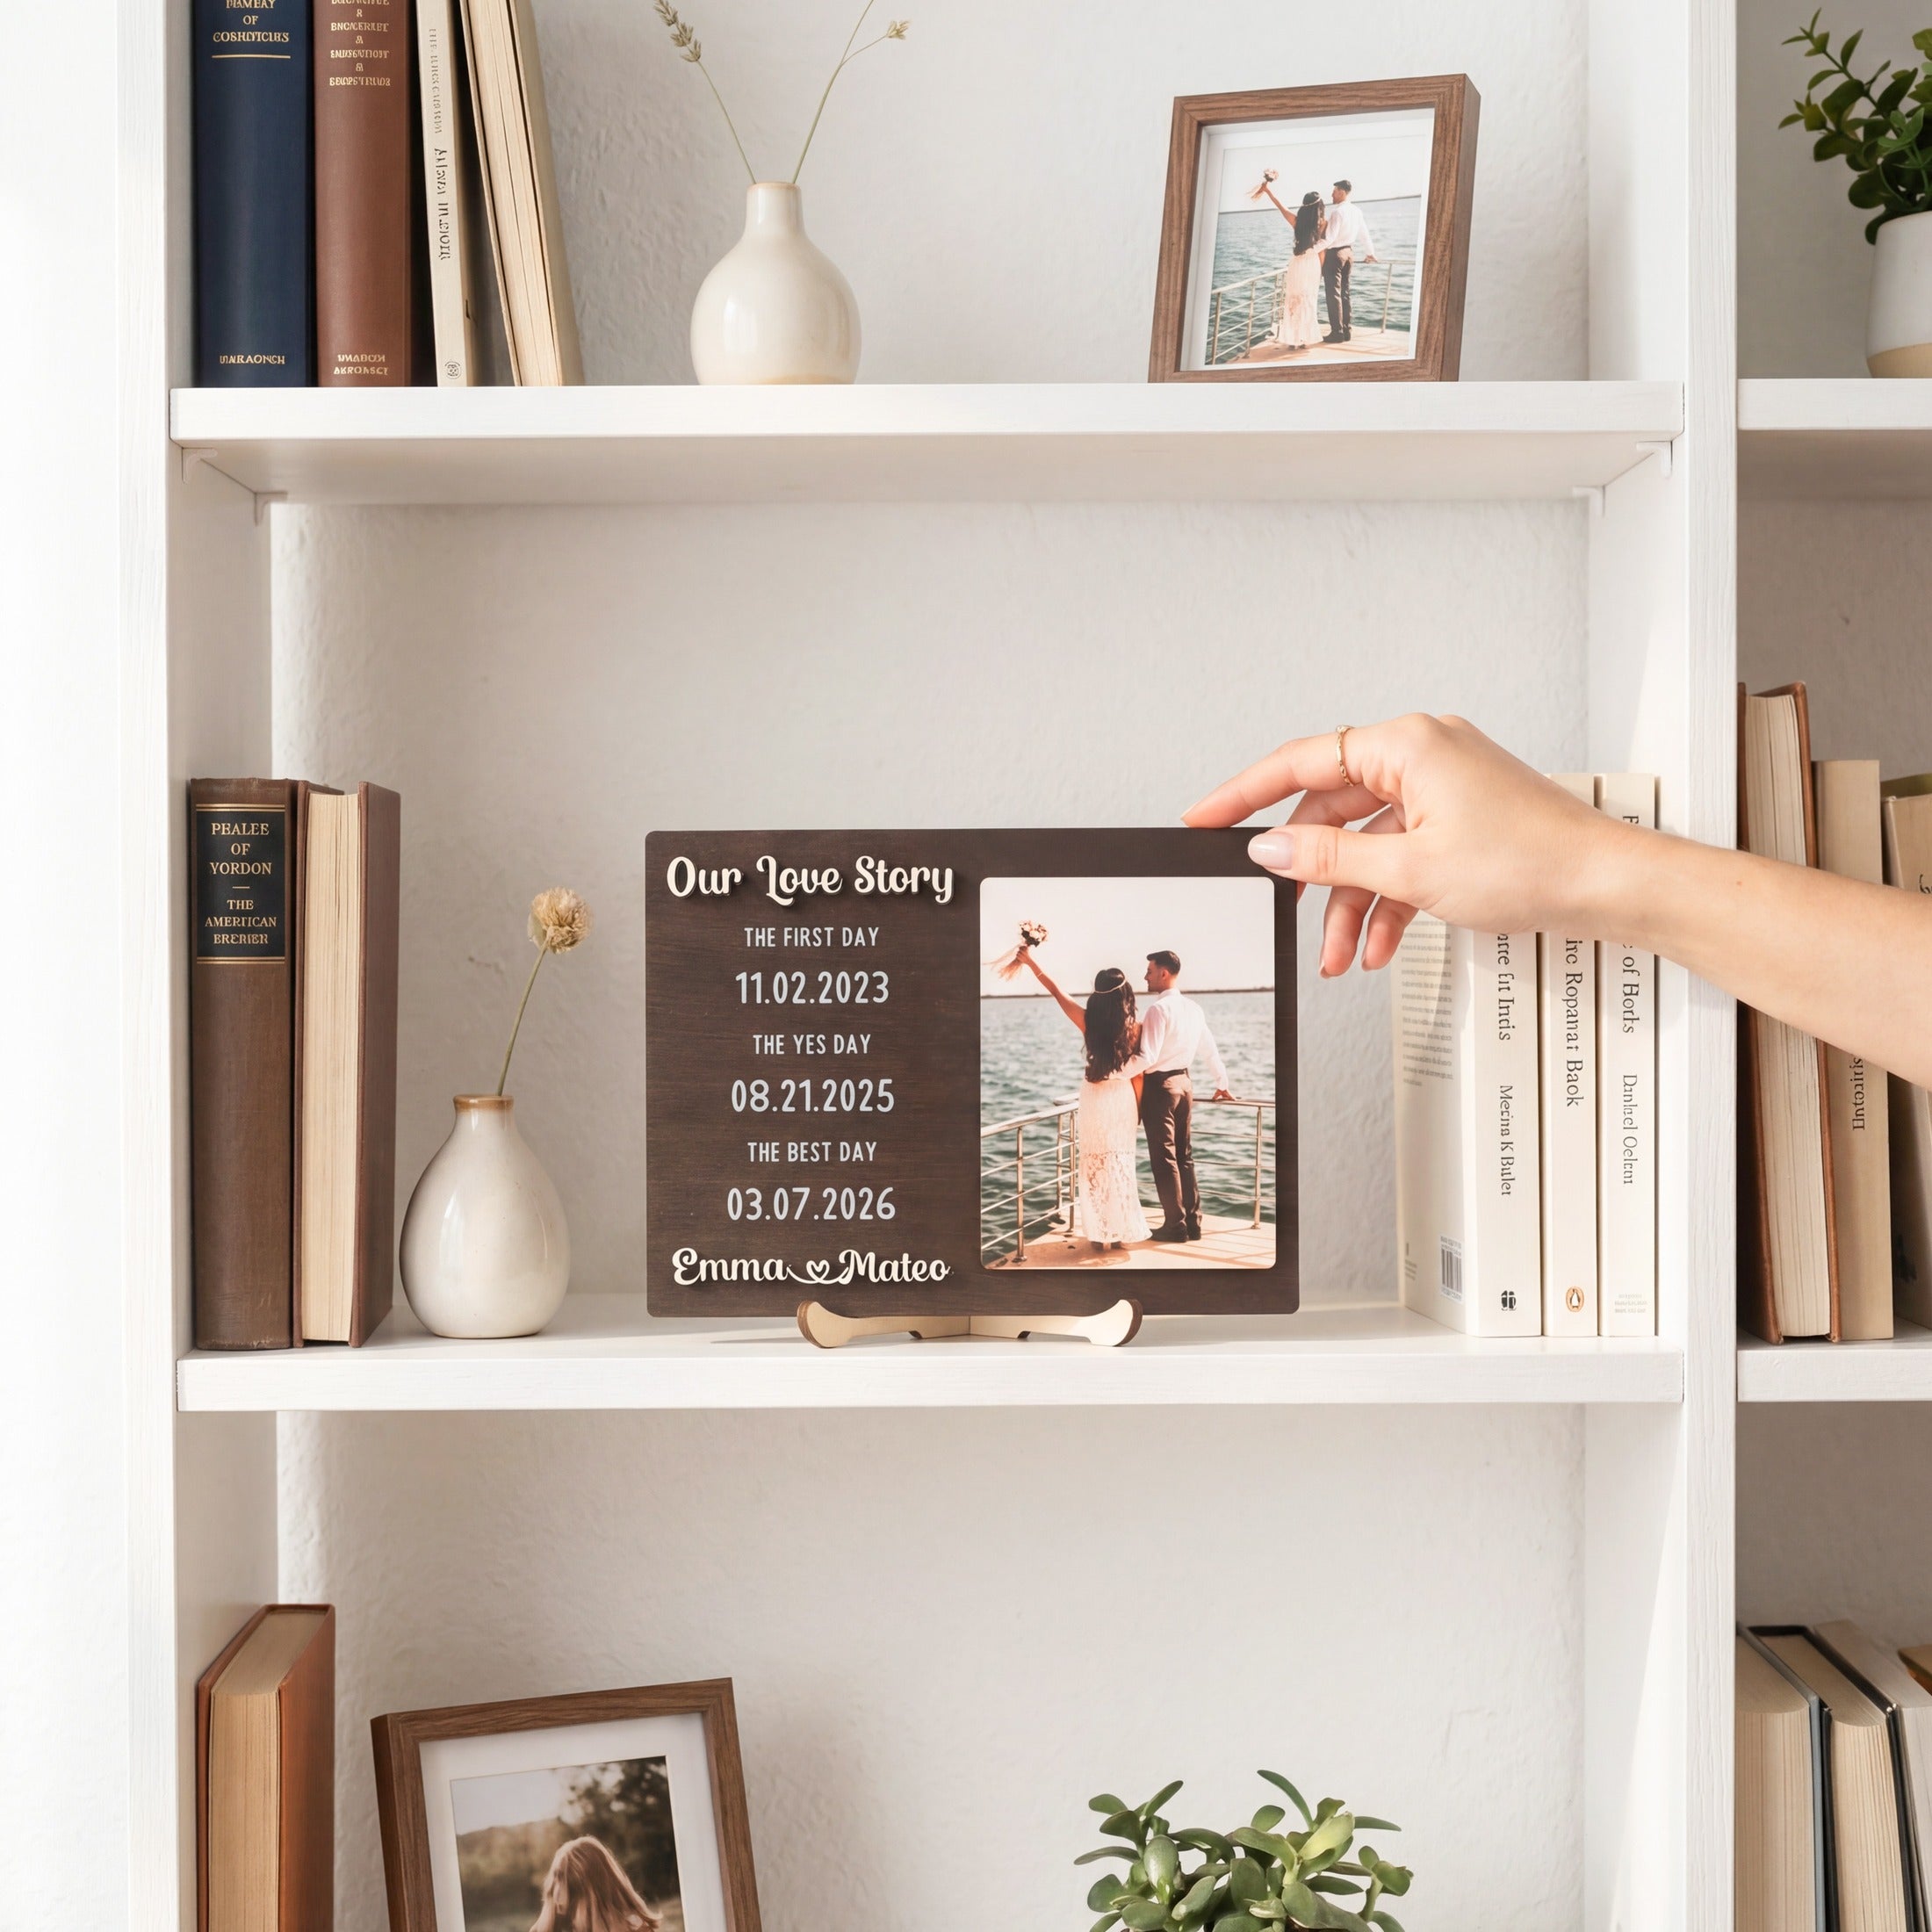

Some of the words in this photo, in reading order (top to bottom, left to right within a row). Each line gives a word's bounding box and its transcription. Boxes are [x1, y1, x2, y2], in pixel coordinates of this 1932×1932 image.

[243, 16, 258, 25] OF
[231, 843, 250, 854] OF
[667, 856, 741, 897] Our
[756, 855, 842, 905] Love
[854, 856, 952, 903] Story
[227, 900, 253, 909] THE
[745, 928, 775, 947] THE
[784, 927, 833, 947] FIRST
[843, 927, 878, 946] DAY
[1623, 957, 1640, 976] of
[736, 971, 888, 1004] 11.02.2023
[753, 1034, 784, 1054] THE
[793, 1034, 825, 1054] YES
[834, 1034, 870, 1054] DAY
[732, 1079, 894, 1112] 08.21.2025
[748, 1143, 779, 1162] THE
[788, 1143, 831, 1162] BEST
[840, 1142, 876, 1161] DAY
[1501, 1143, 1513, 1151] K
[728, 1187, 895, 1220] 03.07.2026
[672, 1247, 789, 1285] Emma
[839, 1249, 950, 1285] Mateo
